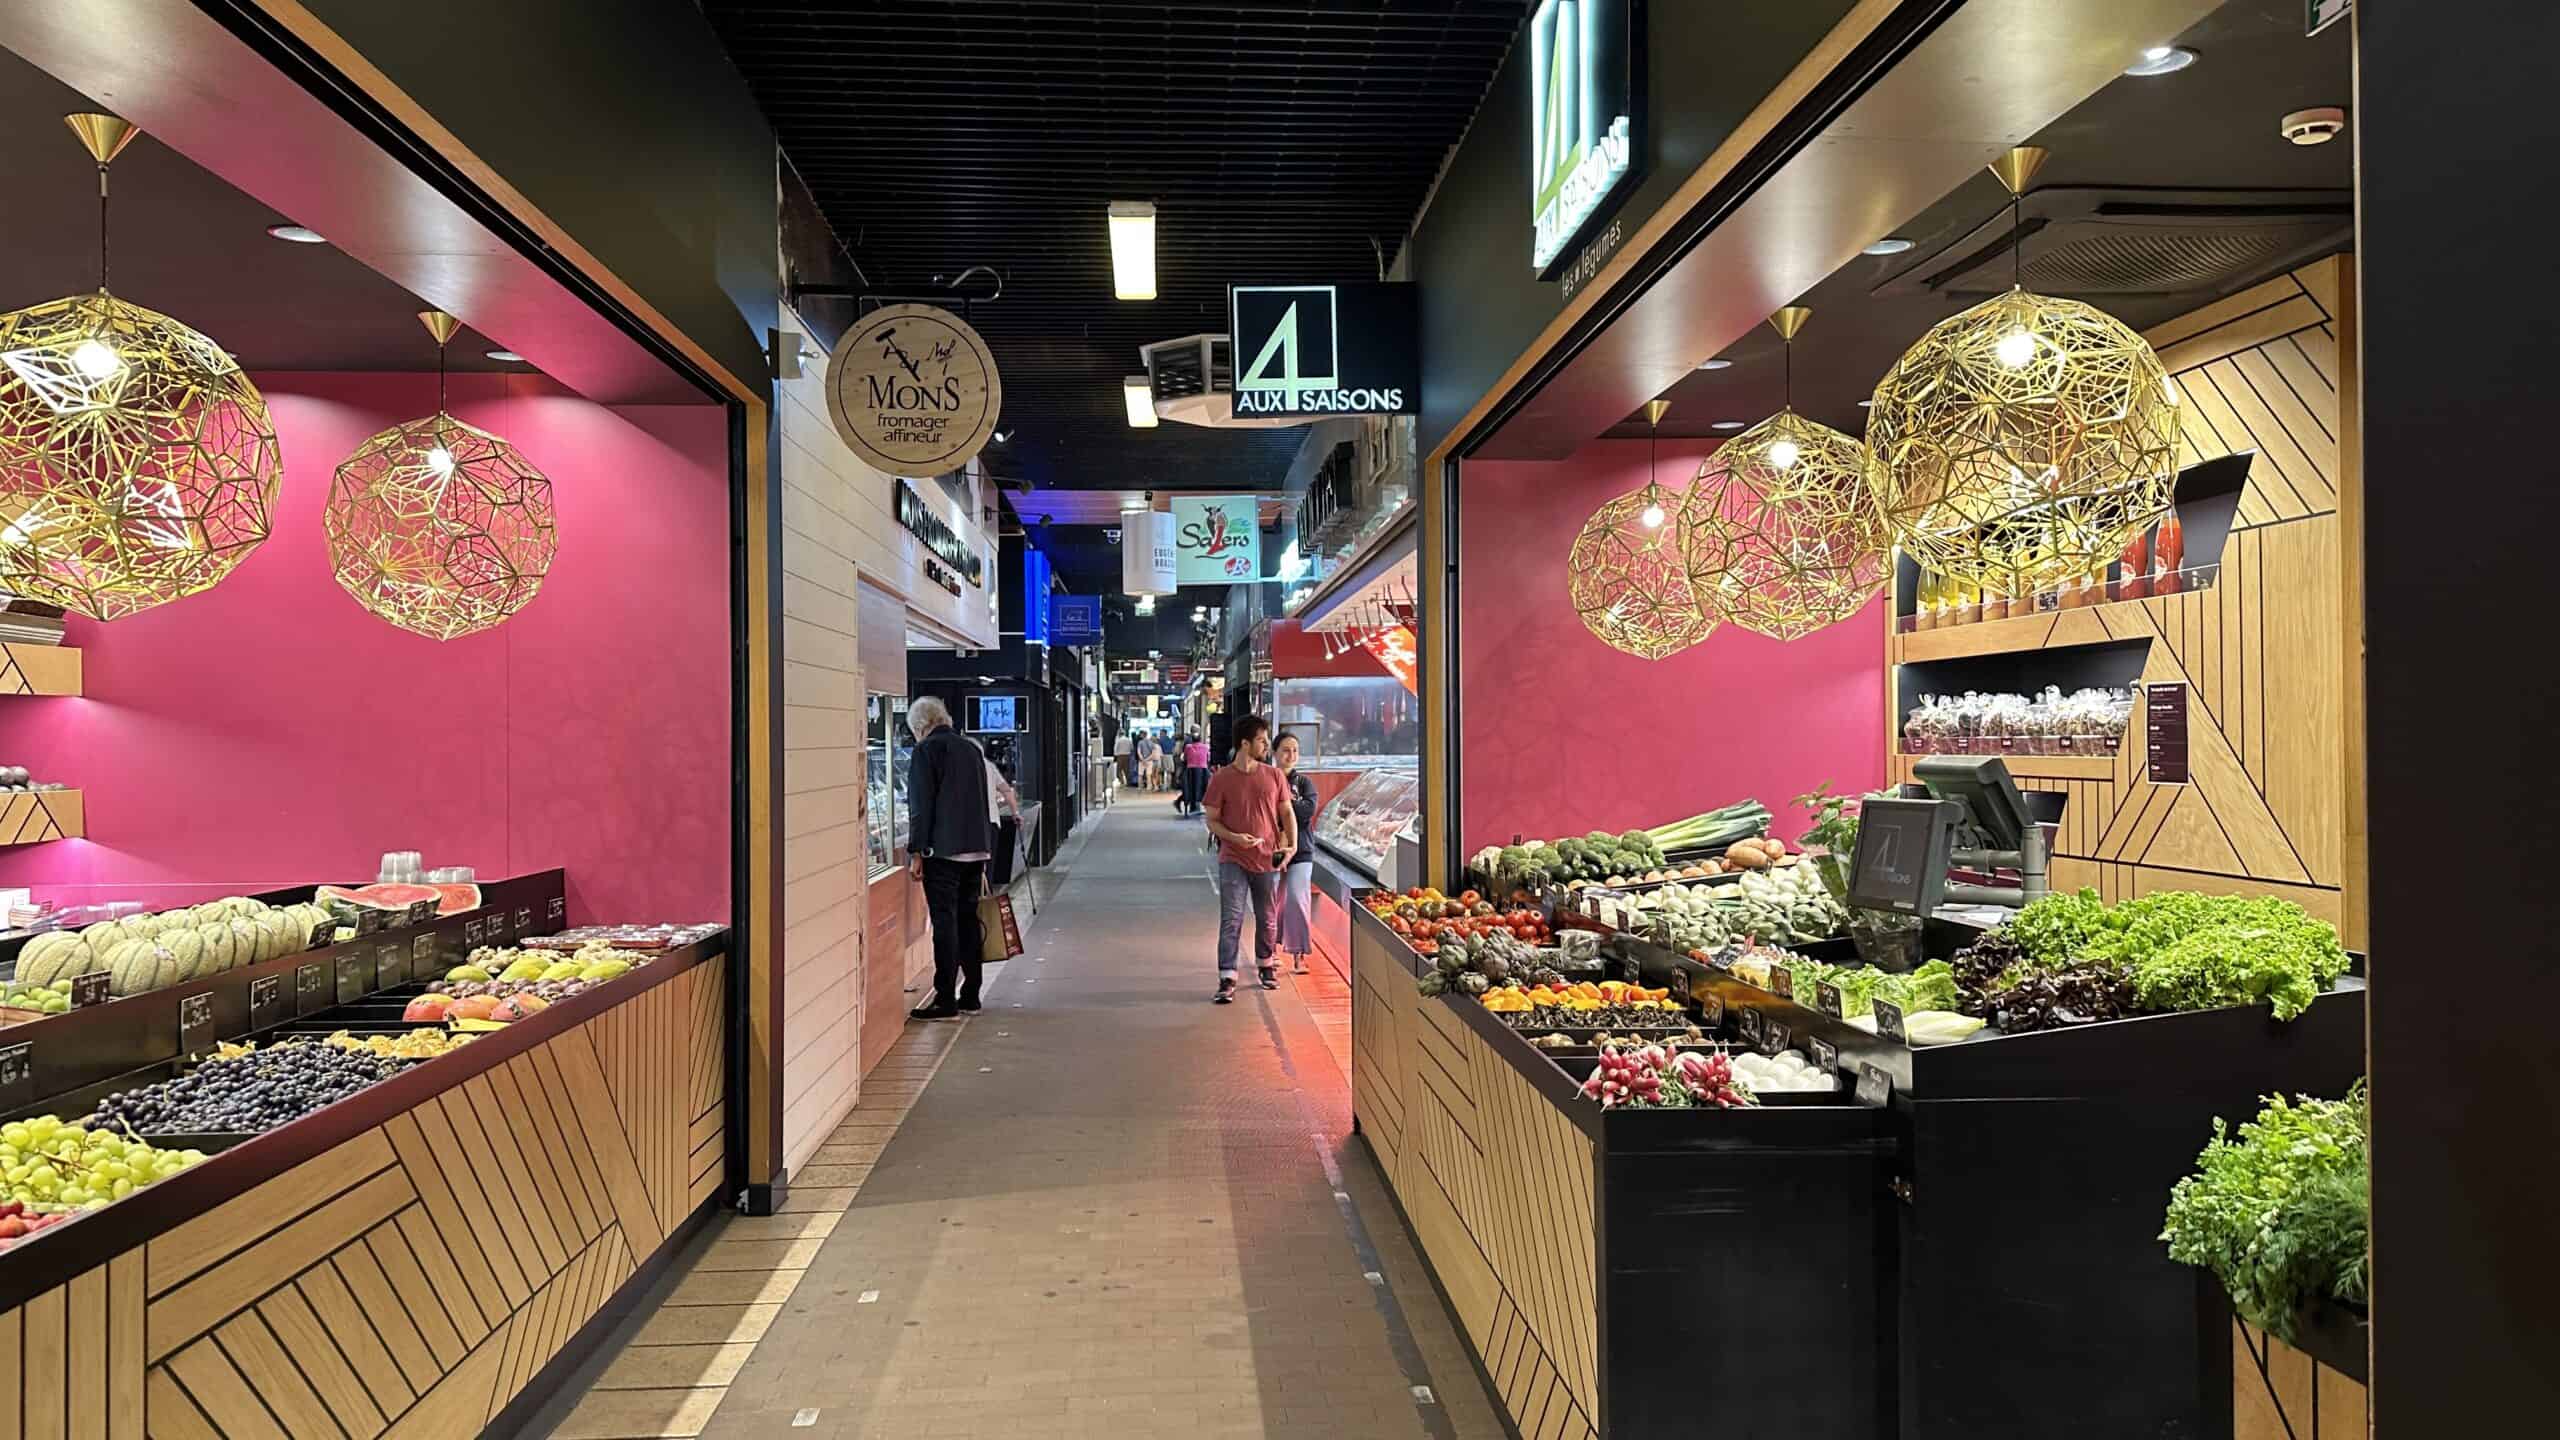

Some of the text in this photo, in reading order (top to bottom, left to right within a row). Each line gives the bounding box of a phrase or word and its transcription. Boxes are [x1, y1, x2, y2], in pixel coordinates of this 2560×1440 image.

[1581, 220, 1622, 278] légumes
[1237, 299, 1404, 412] AUX 4 SAISONS
[877, 413, 950, 432] fromager
[883, 429, 943, 444] affineur
